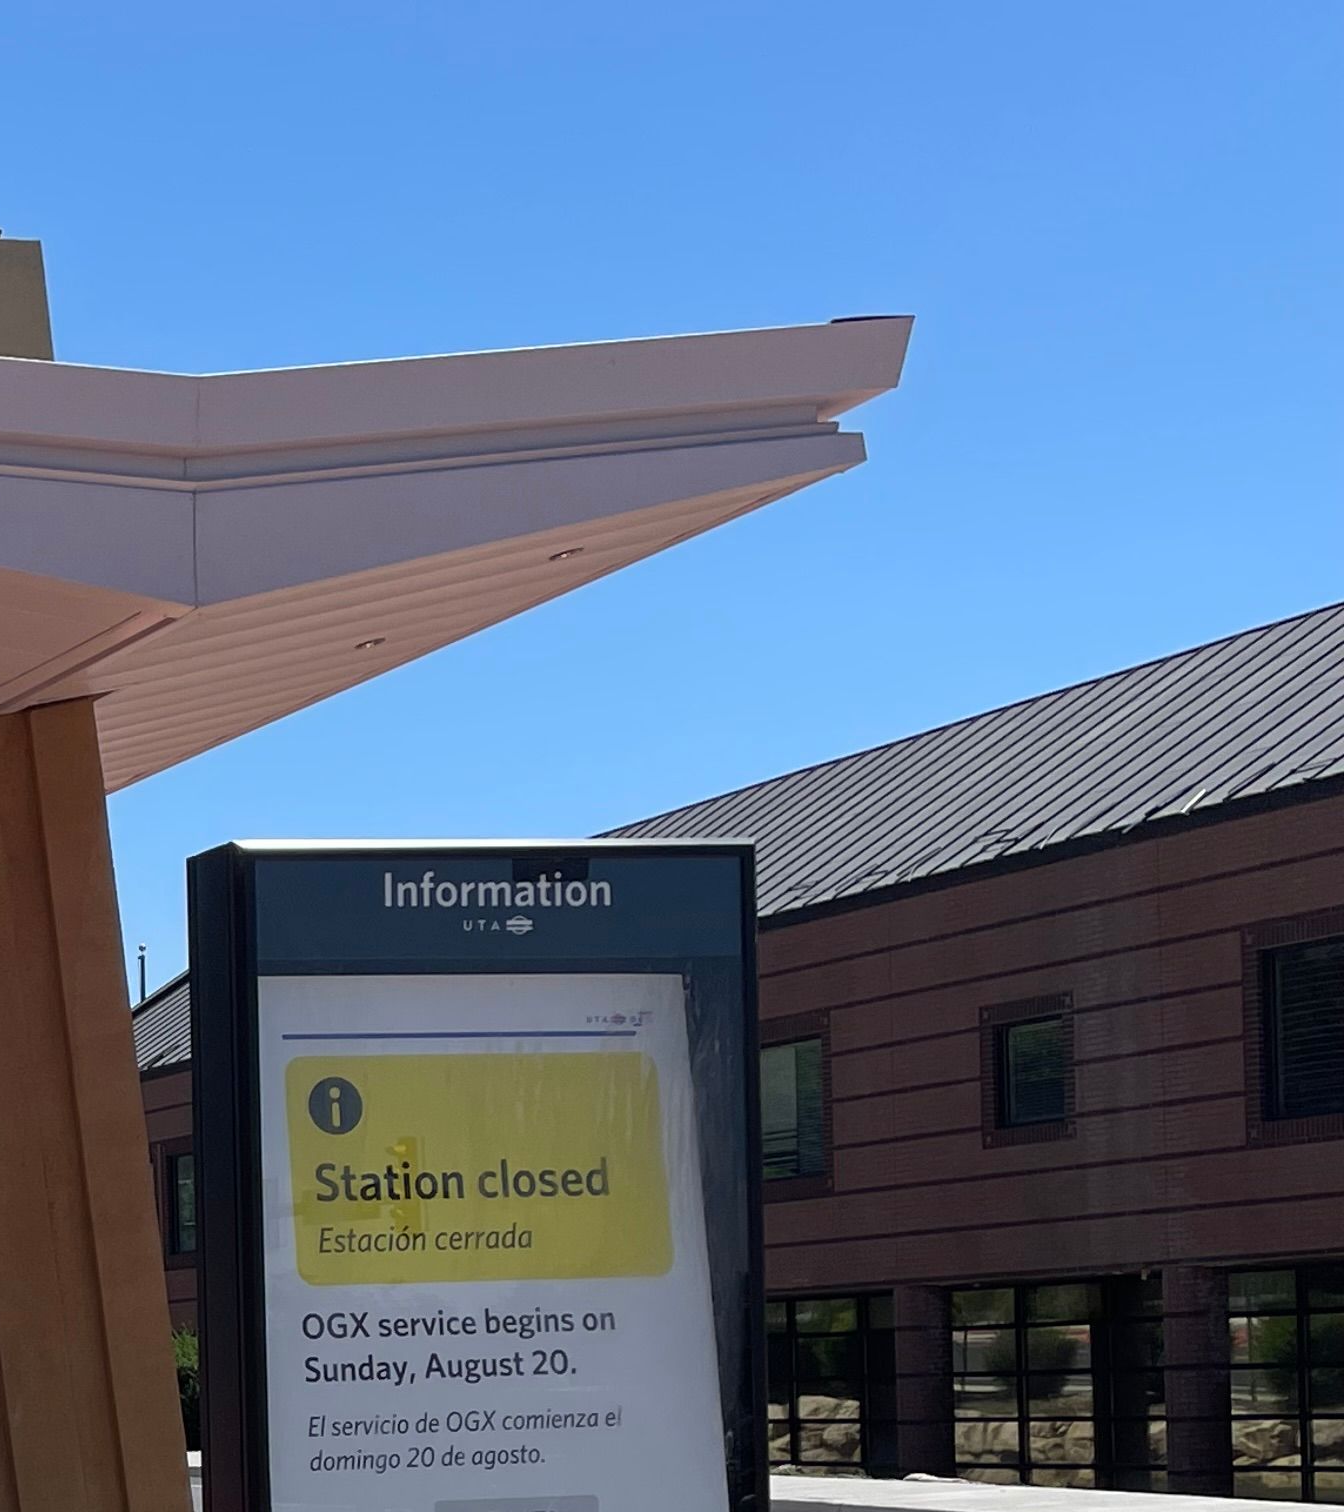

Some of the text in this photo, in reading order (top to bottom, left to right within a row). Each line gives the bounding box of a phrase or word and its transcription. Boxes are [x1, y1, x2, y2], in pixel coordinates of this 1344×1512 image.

[384, 871, 611, 907] Information
[463, 920, 500, 931] UTA
[315, 1157, 610, 1202] Station closed
[318, 1222, 533, 1254] Estación cerrada
[302, 1307, 616, 1340] OGX service begins on
[304, 1349, 578, 1386] Sunday, August 20.
[308, 1404, 623, 1437] El servicio de OGX comienza el
[310, 1444, 546, 1474] domingo 20 de agosto.
